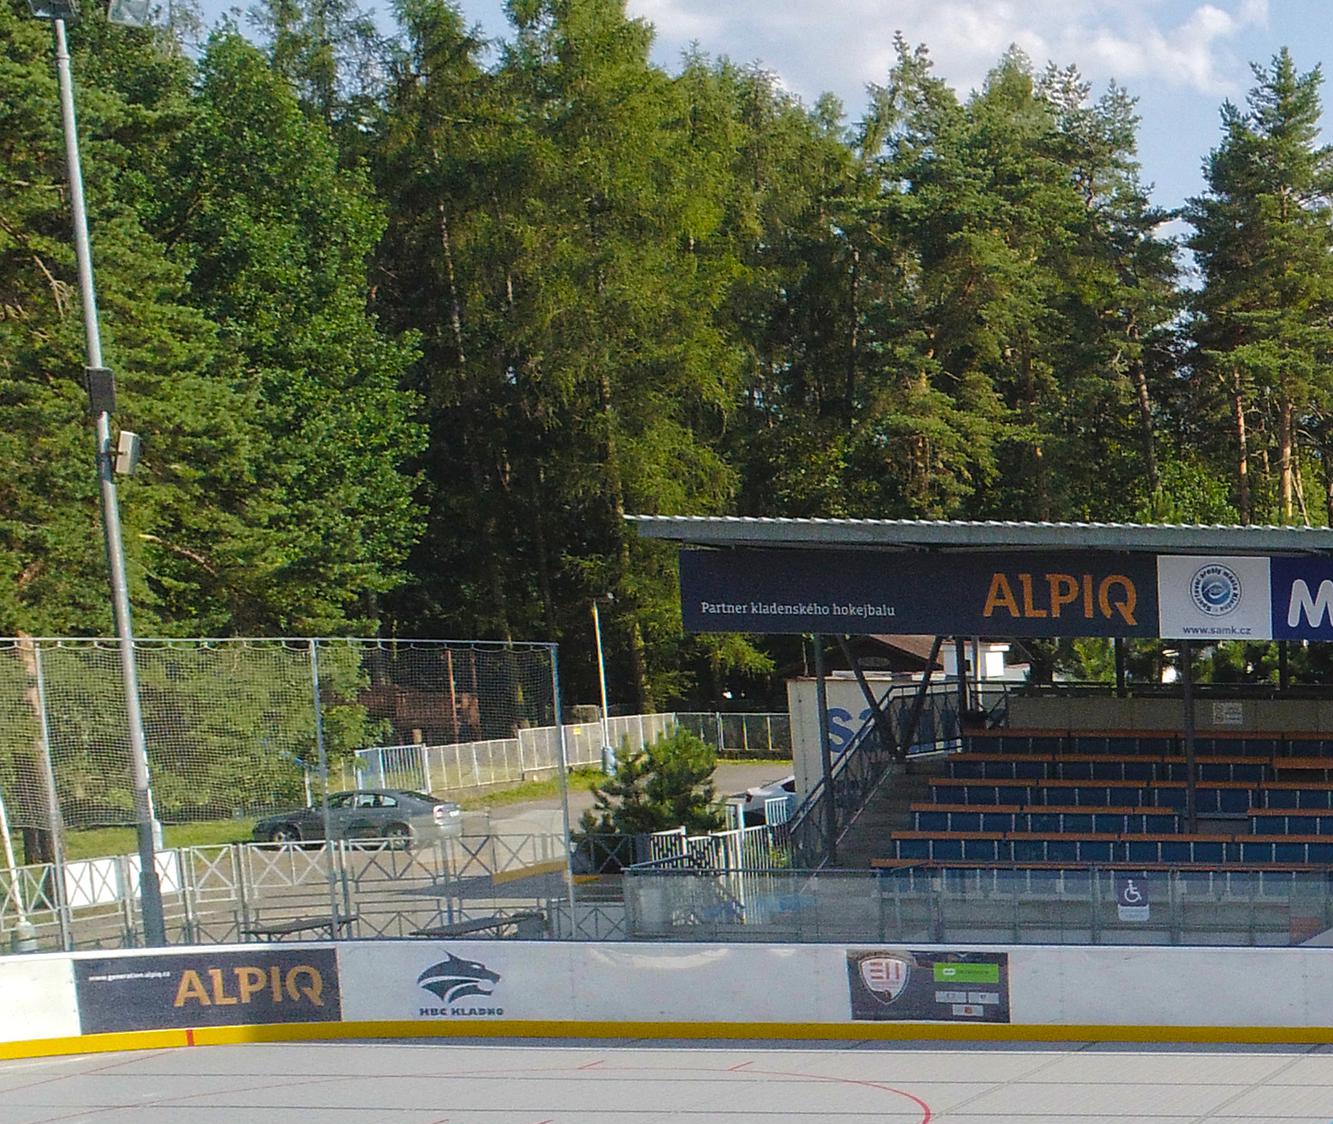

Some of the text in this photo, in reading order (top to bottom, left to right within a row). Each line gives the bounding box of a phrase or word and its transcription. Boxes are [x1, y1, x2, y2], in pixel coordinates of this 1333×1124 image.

[983, 573, 1137, 625] ALPIQ
[701, 602, 895, 618] Partner kladenského hokejbalu
[1183, 626, 1251, 635] www.samk.cz
[174, 965, 325, 1007] ALPIQ
[420, 1008, 504, 1016] HBC KLADNO
